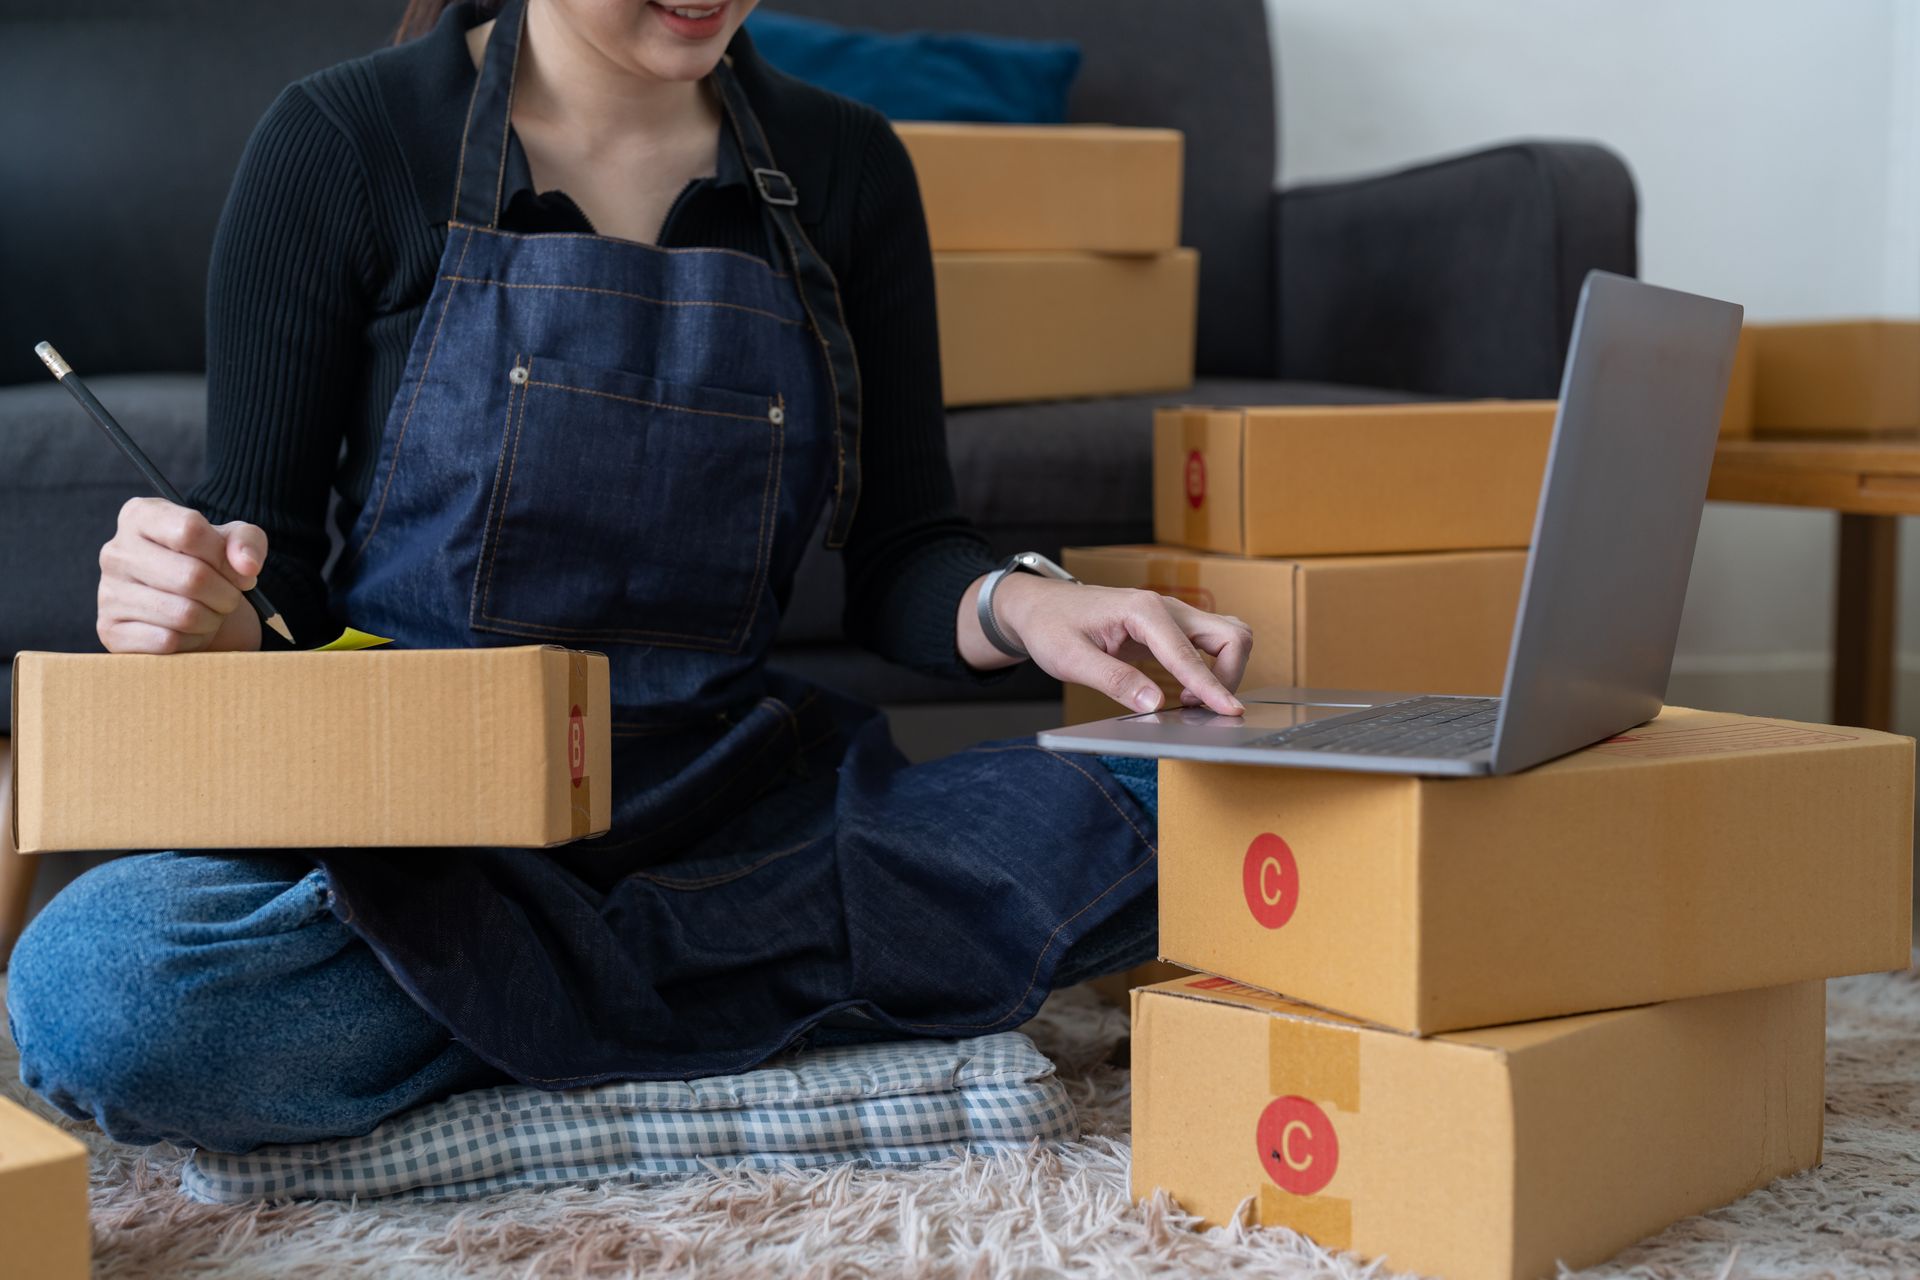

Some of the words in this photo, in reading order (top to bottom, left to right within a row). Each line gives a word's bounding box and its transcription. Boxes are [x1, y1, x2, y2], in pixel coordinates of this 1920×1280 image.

[572, 722, 581, 768] B
[1260, 856, 1282, 906] C
[1281, 1120, 1313, 1171] C
